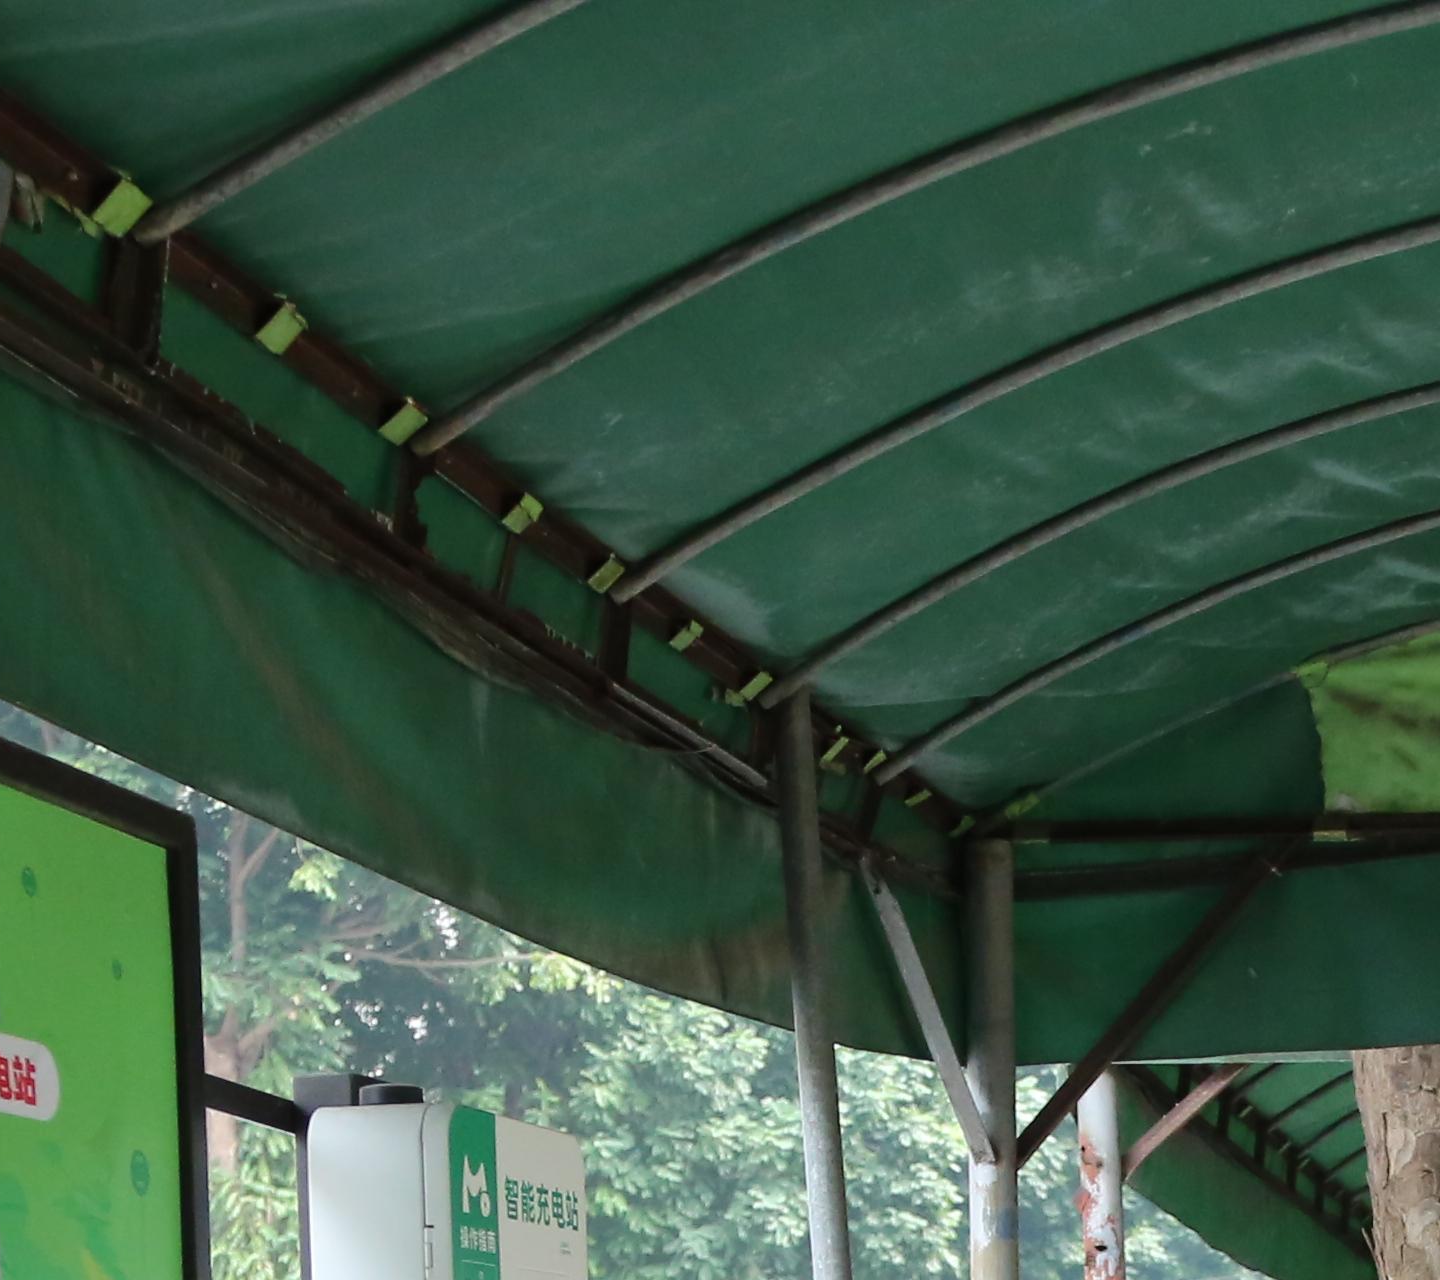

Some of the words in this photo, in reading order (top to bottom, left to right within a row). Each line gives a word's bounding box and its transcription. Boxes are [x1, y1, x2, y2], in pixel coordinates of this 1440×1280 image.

[505, 1176, 579, 1231] 智能充电站
